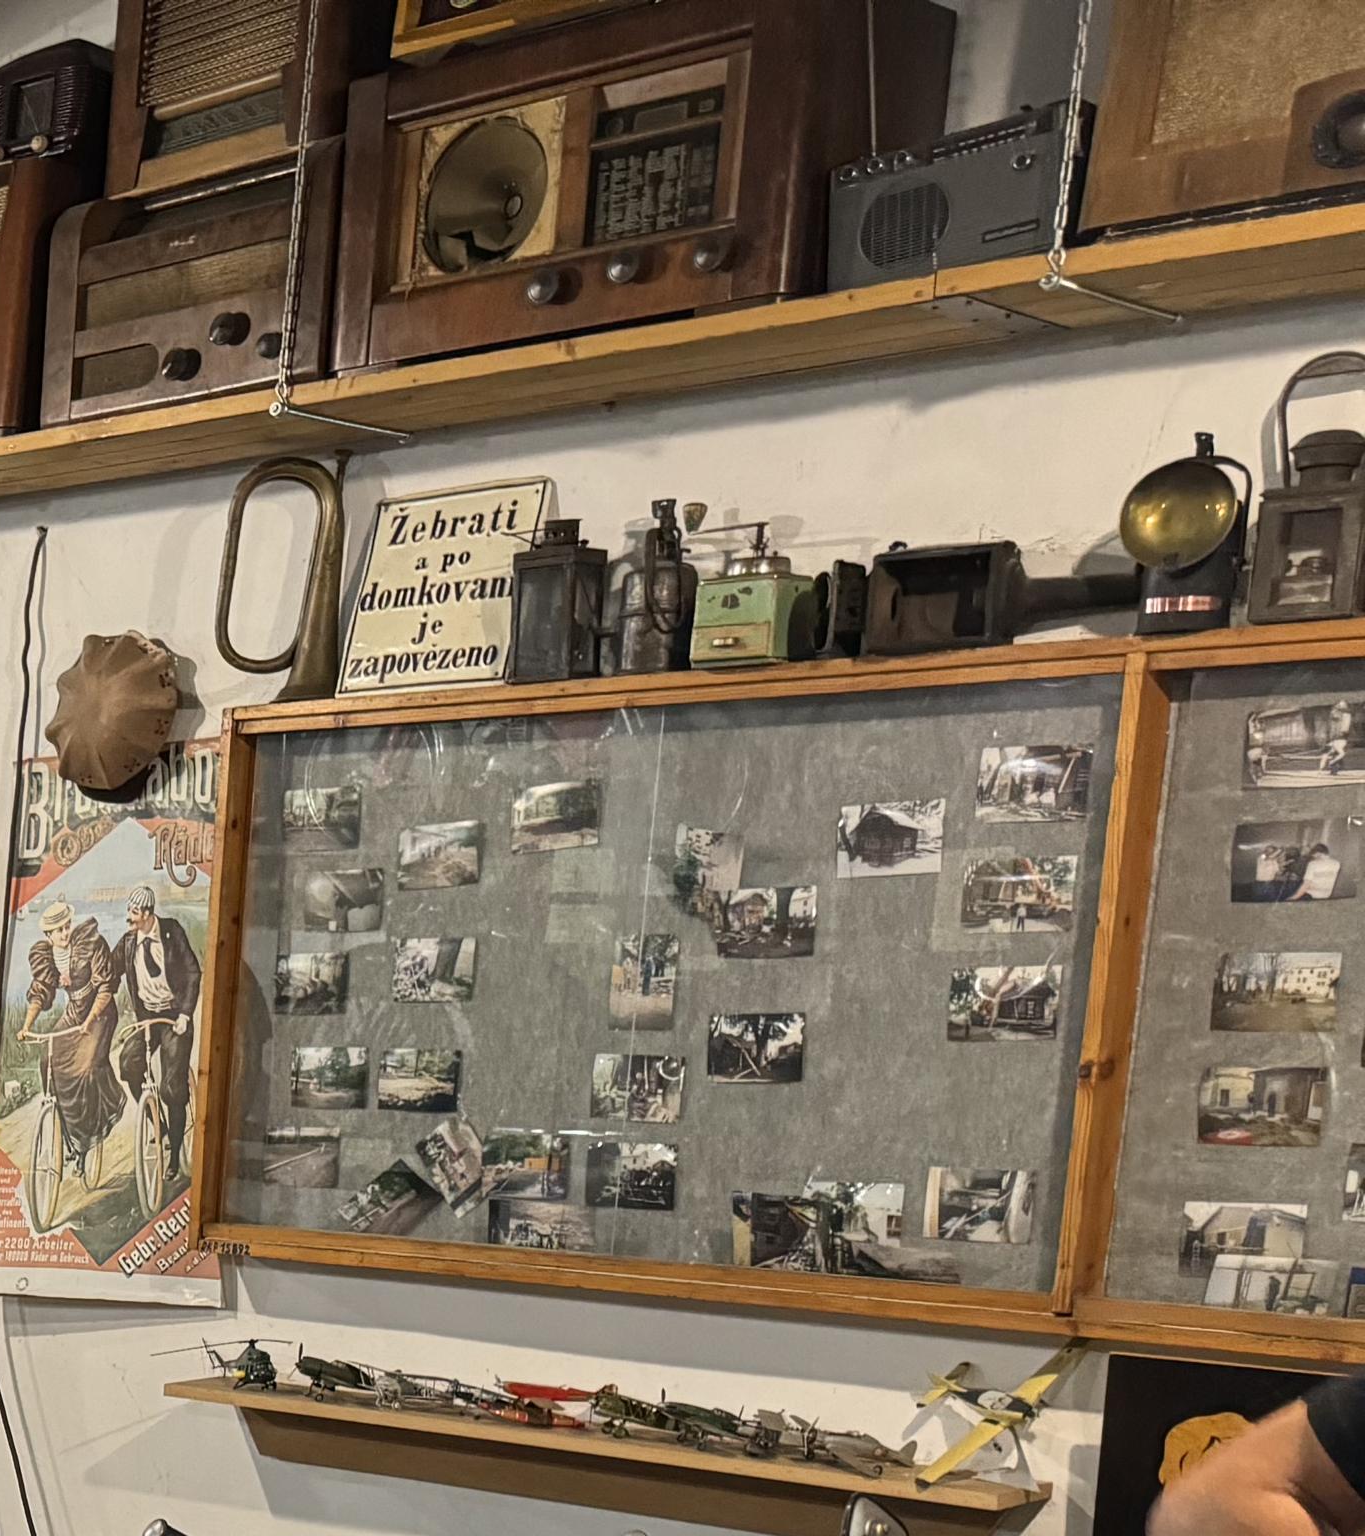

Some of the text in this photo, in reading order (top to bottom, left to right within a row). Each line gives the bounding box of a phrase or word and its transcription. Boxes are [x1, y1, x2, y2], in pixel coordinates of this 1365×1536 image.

[388, 500, 519, 547] Žebrati
[415, 550, 471, 574] a po
[411, 612, 443, 645] je
[347, 643, 498, 684] zapovězeno
[118, 1235, 161, 1275] Gebr.
